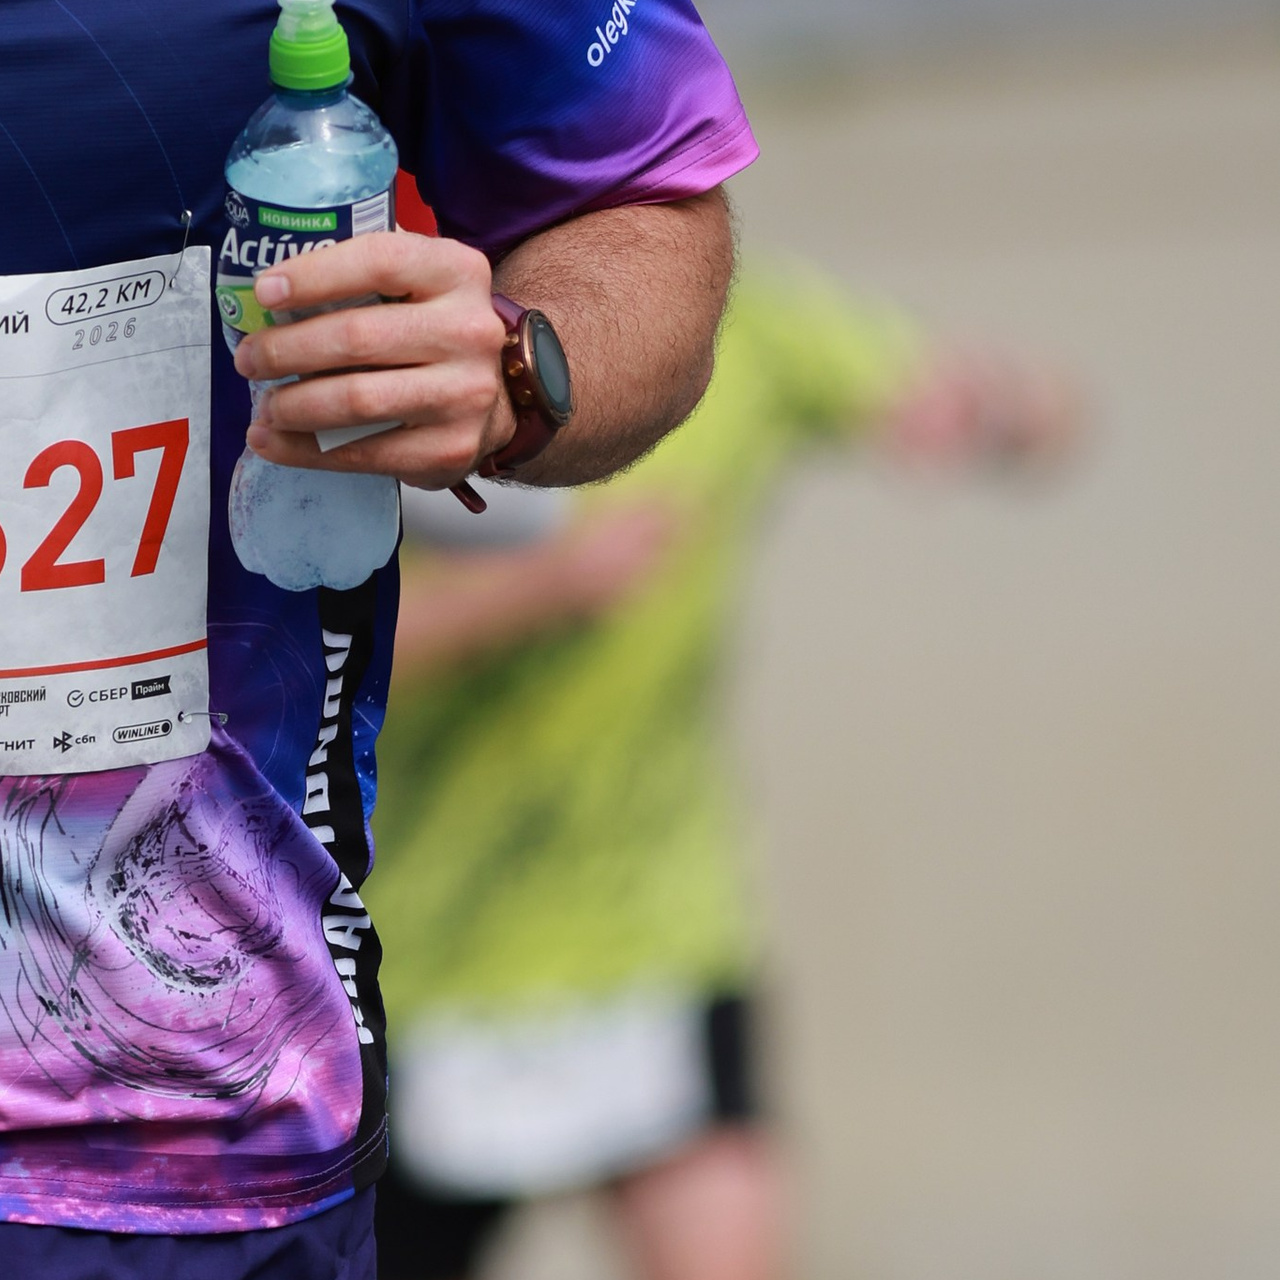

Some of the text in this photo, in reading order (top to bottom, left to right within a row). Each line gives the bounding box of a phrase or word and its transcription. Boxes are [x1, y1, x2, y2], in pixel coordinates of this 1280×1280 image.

[262, 211, 332, 228] НОВИНКА
[61, 288, 108, 315] 42,2
[72, 317, 136, 350] 2026
[88, 683, 165, 702] СБЕР Прайм
[75, 734, 96, 745] сбп
[117, 724, 160, 740] WINLINE
